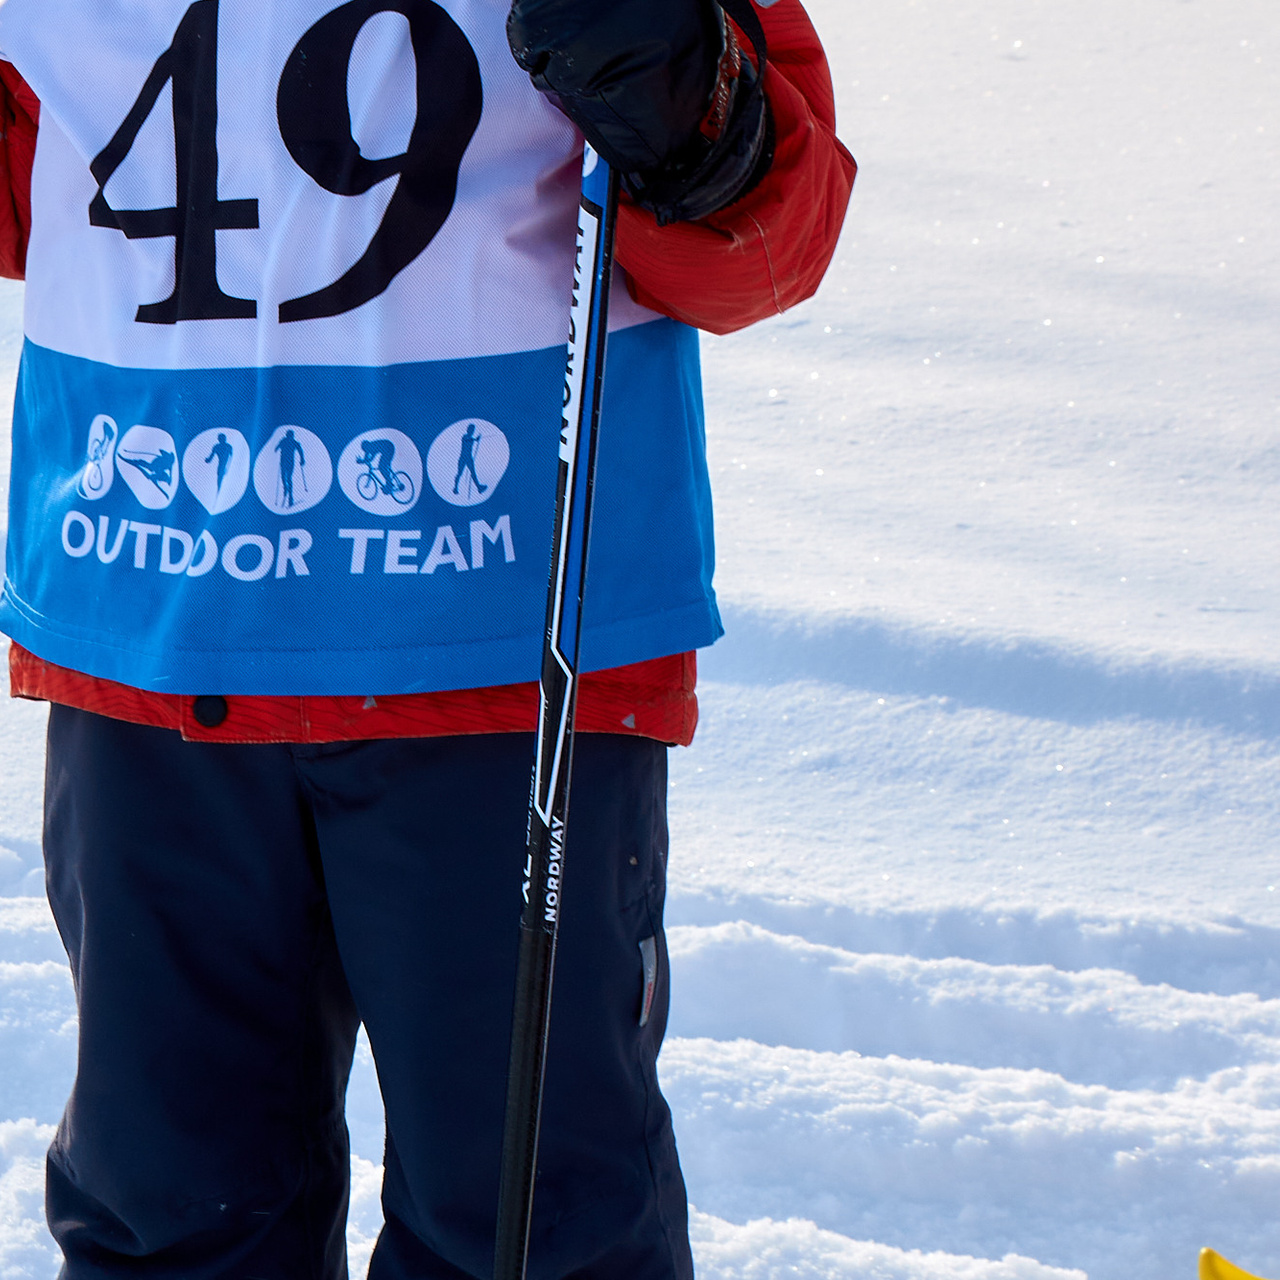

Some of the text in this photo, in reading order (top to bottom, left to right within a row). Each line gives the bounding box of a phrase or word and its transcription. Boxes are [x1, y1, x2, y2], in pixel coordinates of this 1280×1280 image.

[61, 510, 313, 582] OUTDOOR
[338, 514, 516, 575] TEAM
[544, 814, 564, 923] NORDWAY
